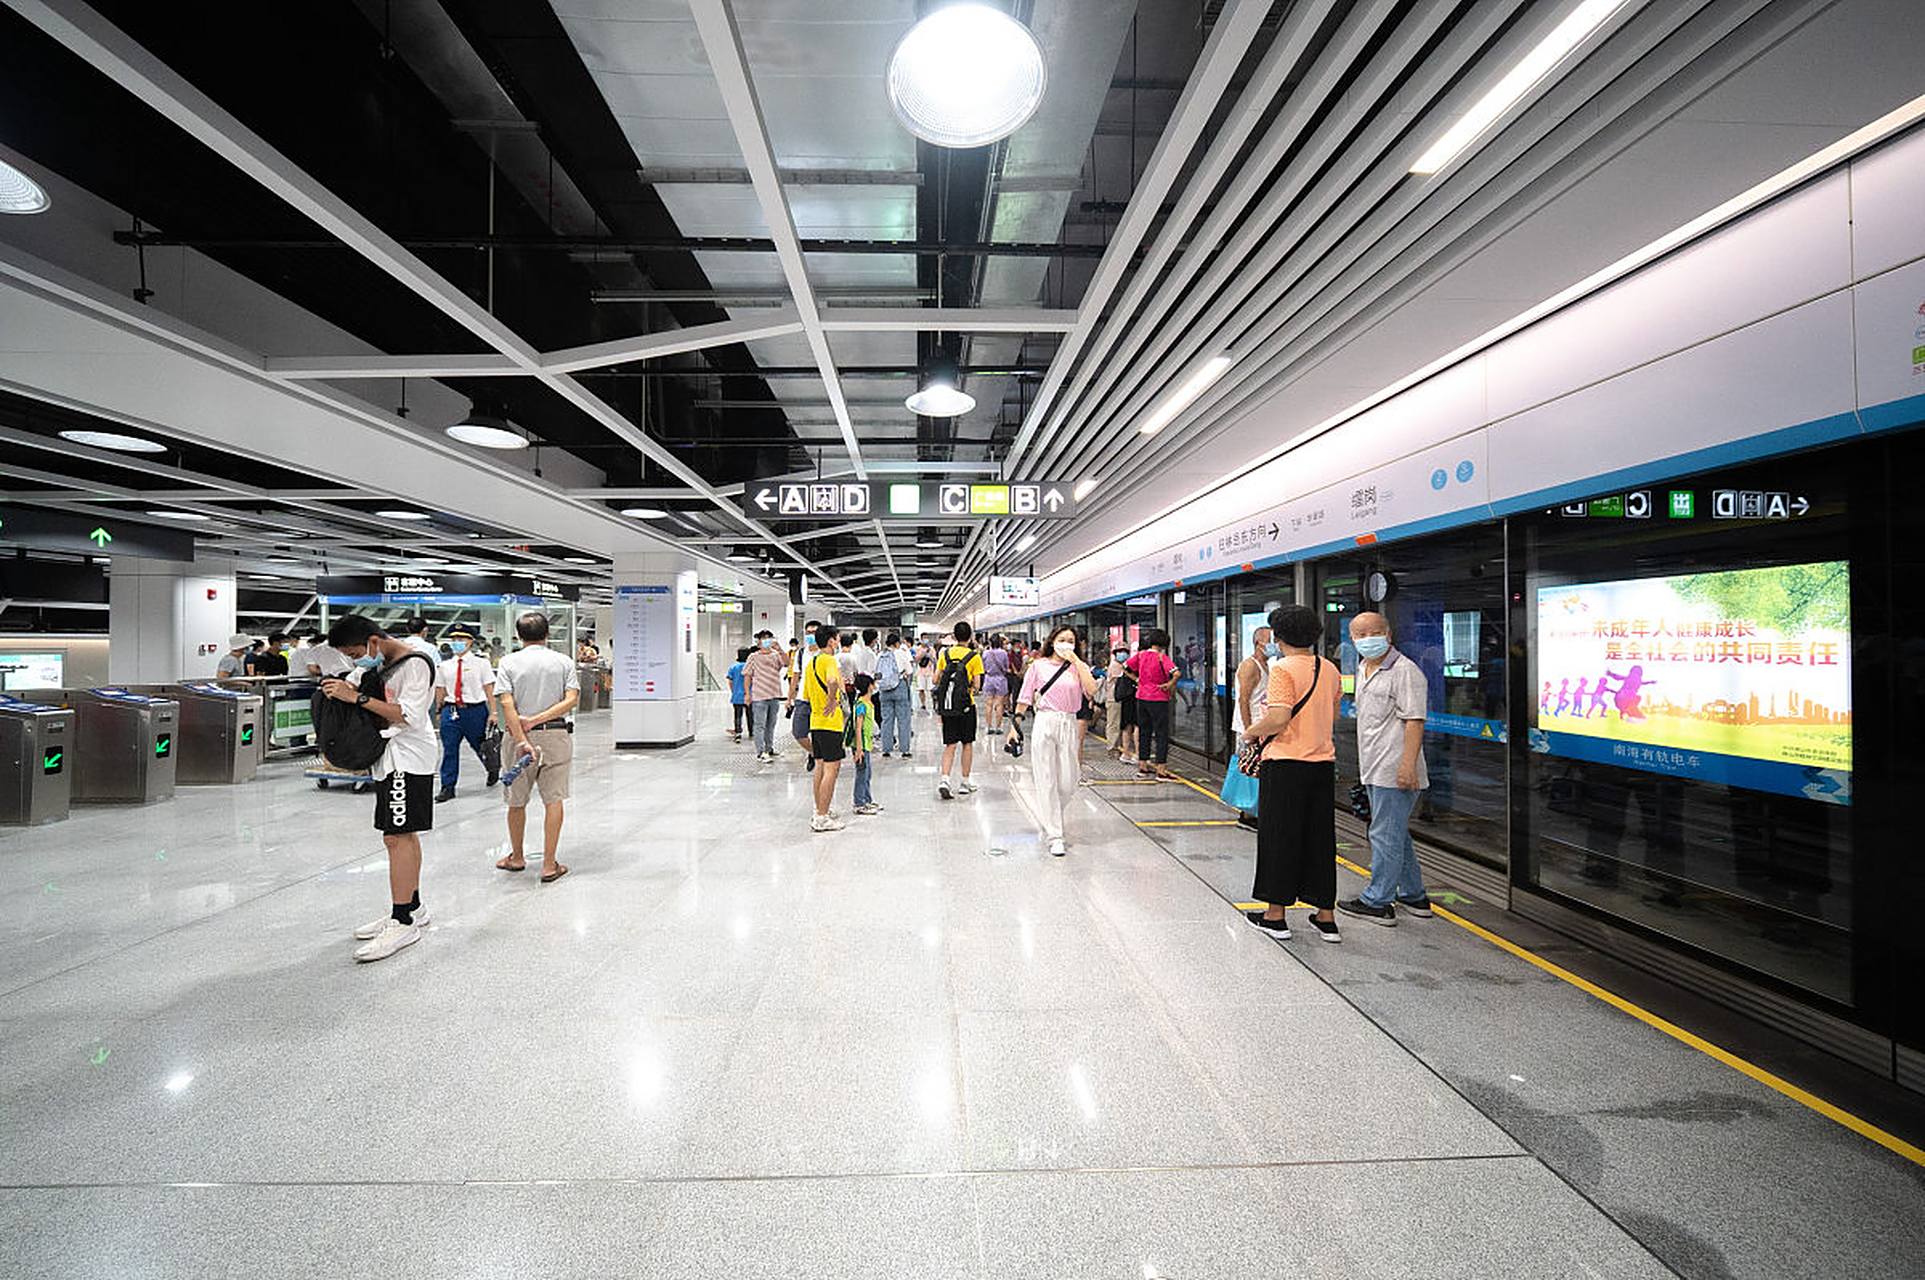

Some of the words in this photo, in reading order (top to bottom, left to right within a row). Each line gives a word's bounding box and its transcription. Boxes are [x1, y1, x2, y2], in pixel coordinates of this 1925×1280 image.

[782, 488, 805, 511] A
[844, 488, 866, 511] D
[943, 488, 966, 511] C
[1015, 488, 1038, 511] B
[1592, 618, 1756, 639] 未成年人健康成长
[1605, 641, 1839, 666] 是全社会的共同责任
[389, 771, 407, 827] adidas
